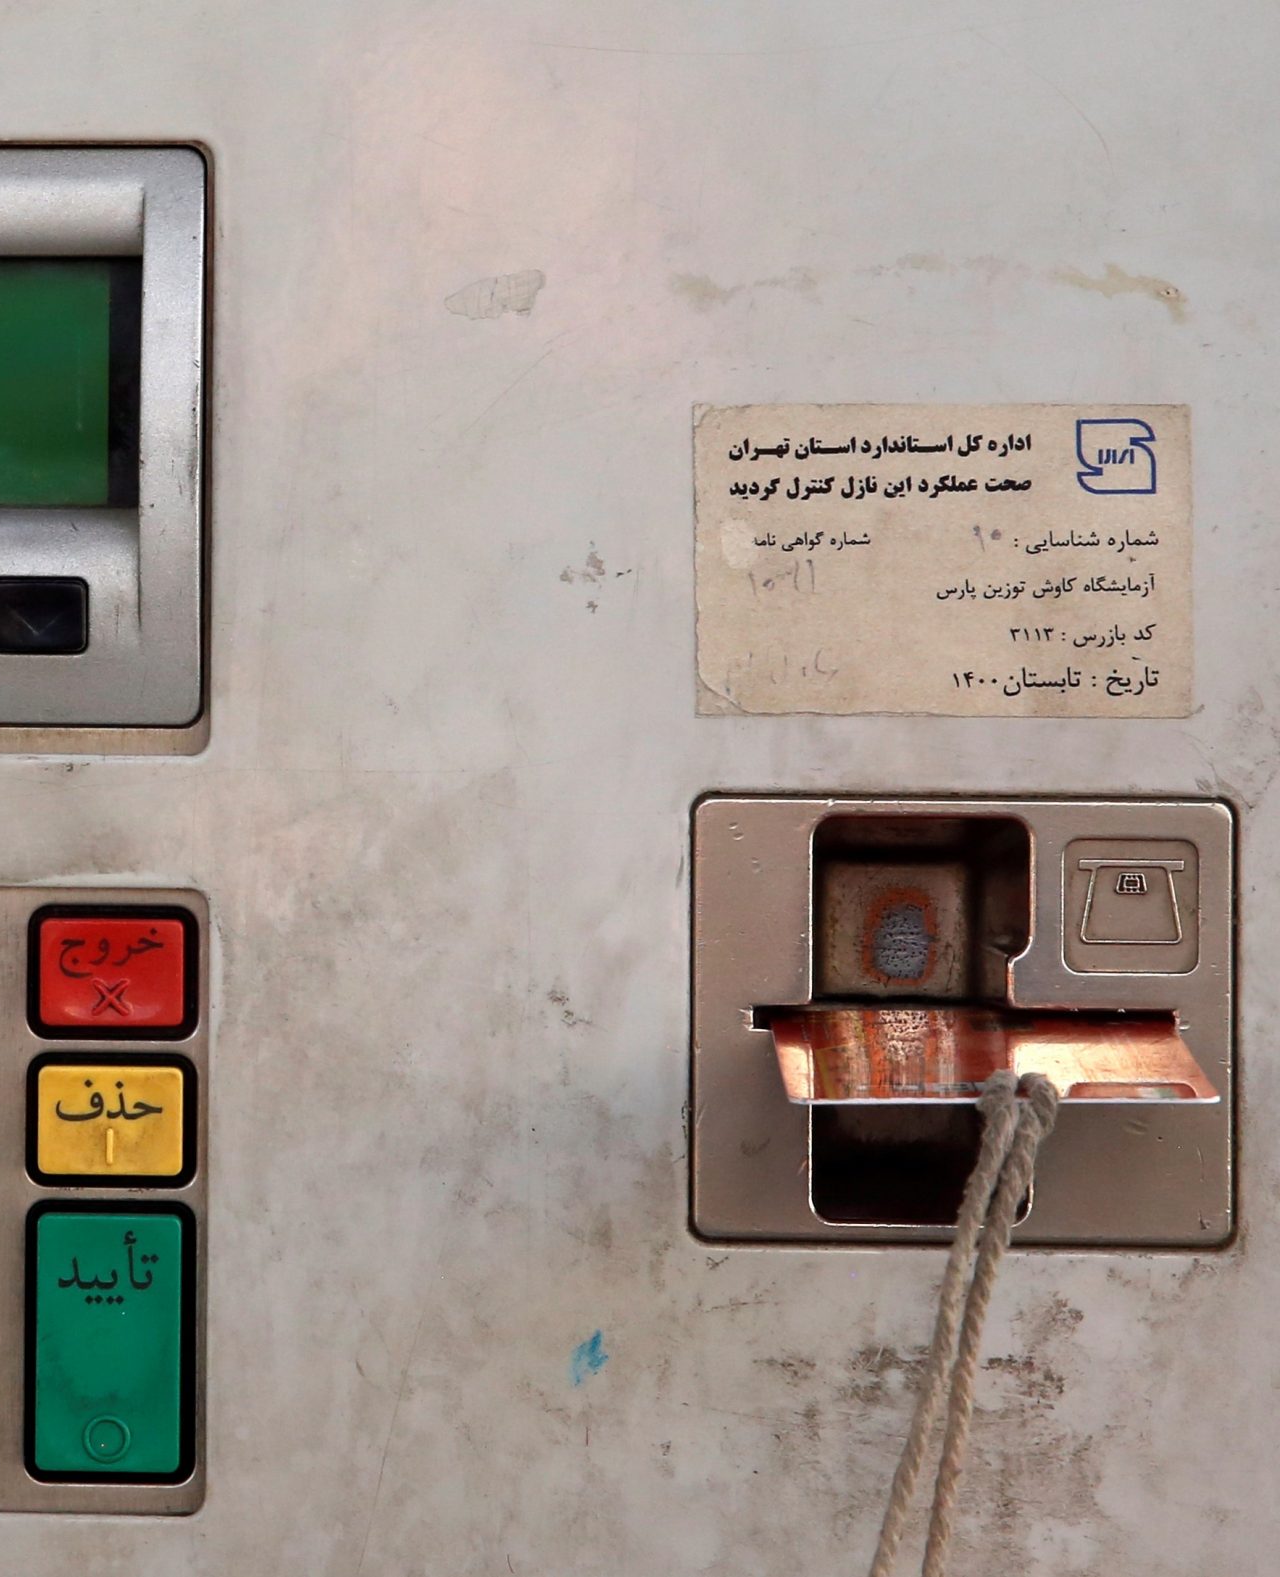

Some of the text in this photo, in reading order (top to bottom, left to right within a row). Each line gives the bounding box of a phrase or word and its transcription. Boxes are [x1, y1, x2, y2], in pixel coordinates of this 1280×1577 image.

[728, 432, 1033, 462] اداره کل استاندارد استان تهران
[786, 475, 836, 501] کنترل
[840, 475, 878, 500] نازل
[883, 475, 913, 499] این
[917, 474, 979, 499] عملکرد
[984, 477, 1033, 493] صحت
[781, 530, 825, 552] گواهی
[829, 531, 872, 551] شماره
[1024, 529, 1101, 555] شناسایی
[1107, 528, 1160, 553] شماره
[936, 571, 1156, 601] آزمایشگاه کاوش توزین پارس
[1072, 623, 1127, 648] بازرس
[1132, 622, 1158, 642] کد
[1104, 665, 1161, 696] تاریخ
[58, 927, 165, 979] خروج
[55, 1079, 163, 1122] حذف
